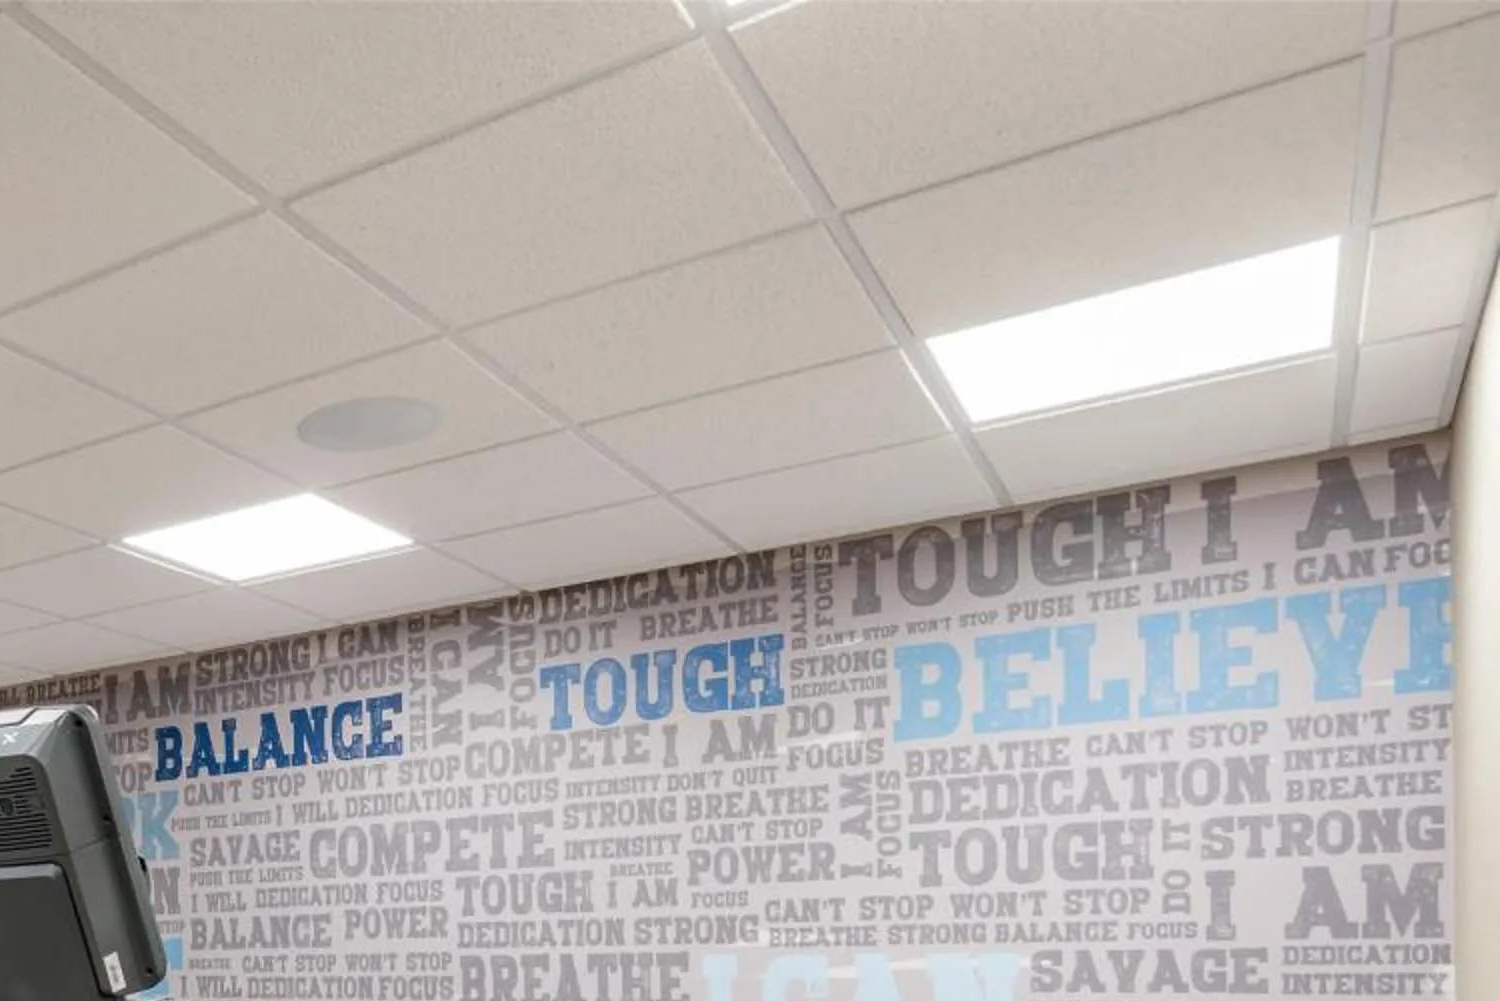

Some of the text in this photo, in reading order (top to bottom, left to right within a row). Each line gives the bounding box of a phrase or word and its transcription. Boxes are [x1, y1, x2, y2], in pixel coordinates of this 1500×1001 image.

[838, 484, 1171, 618] TOUGH
[1200, 472, 1238, 566] I
[538, 552, 776, 624] DEDICATION
[1293, 549, 1374, 585] CAN
[1006, 568, 1250, 624] PUSH THE LIMITS
[544, 619, 617, 658] DO IT
[640, 594, 779, 642] BREATHE
[195, 635, 311, 687] STRONG
[337, 619, 398, 661] CAN
[539, 632, 785, 732] TOUGH
[790, 646, 887, 680] STRONG
[103, 661, 191, 725] I AM
[194, 655, 404, 716] INTENSITY FOCUS
[430, 638, 463, 748] CAN
[791, 674, 887, 699] DEDICATION
[154, 692, 403, 782] BALANCE
[788, 694, 890, 738] DO IT
[1085, 708, 1391, 759] CAN'T STOP WON'T
[464, 723, 650, 780] COMPETE
[702, 714, 779, 764] AM
[786, 737, 885, 772] FOCUS
[905, 736, 1070, 777] BREATHE
[1284, 736, 1453, 772] INTENSITY
[183, 755, 461, 807] CAN'T STOP STOP
[732, 764, 779, 786] QUIT
[908, 752, 1271, 825] DEDICATION
[1285, 769, 1442, 803] BREATHE
[345, 777, 559, 820] DEDICATION FOCUS
[562, 795, 678, 831] STRONG
[684, 783, 830, 822] BREATHE
[839, 771, 873, 843] AM
[309, 809, 555, 880] COMPETE
[765, 817, 823, 840] STOP
[876, 768, 903, 880] FOCUS
[1201, 804, 1445, 861] STRONG
[189, 830, 300, 868] SAVAGE
[563, 832, 682, 861] INTENSITY
[686, 840, 836, 886] POWER
[909, 817, 1154, 888] TOUGH
[1162, 817, 1191, 915] DO IT
[205, 880, 443, 912] WILL DEDICATION FOCUS
[455, 869, 594, 916] TOUGH
[631, 878, 678, 908] AM
[691, 890, 748, 908] FOCUS
[764, 886, 1151, 924] CAN'T STOP WON'T STOP
[1205, 861, 1444, 940] I AM
[190, 914, 332, 949] BALANCE
[343, 905, 448, 940] POWER
[457, 913, 760, 948] DEDICATION STRONG
[769, 919, 1119, 947] BREATHE STRONG BALANCE
[1127, 920, 1198, 940] FOCUS
[241, 952, 452, 972] CAN'T STOP STOP
[1030, 947, 1269, 993] SAVAGE
[1282, 944, 1453, 966] DEDICATION
[195, 974, 454, 1000] WILL DEDICATION FOCUS
[1281, 972, 1449, 995] INTENSITY
